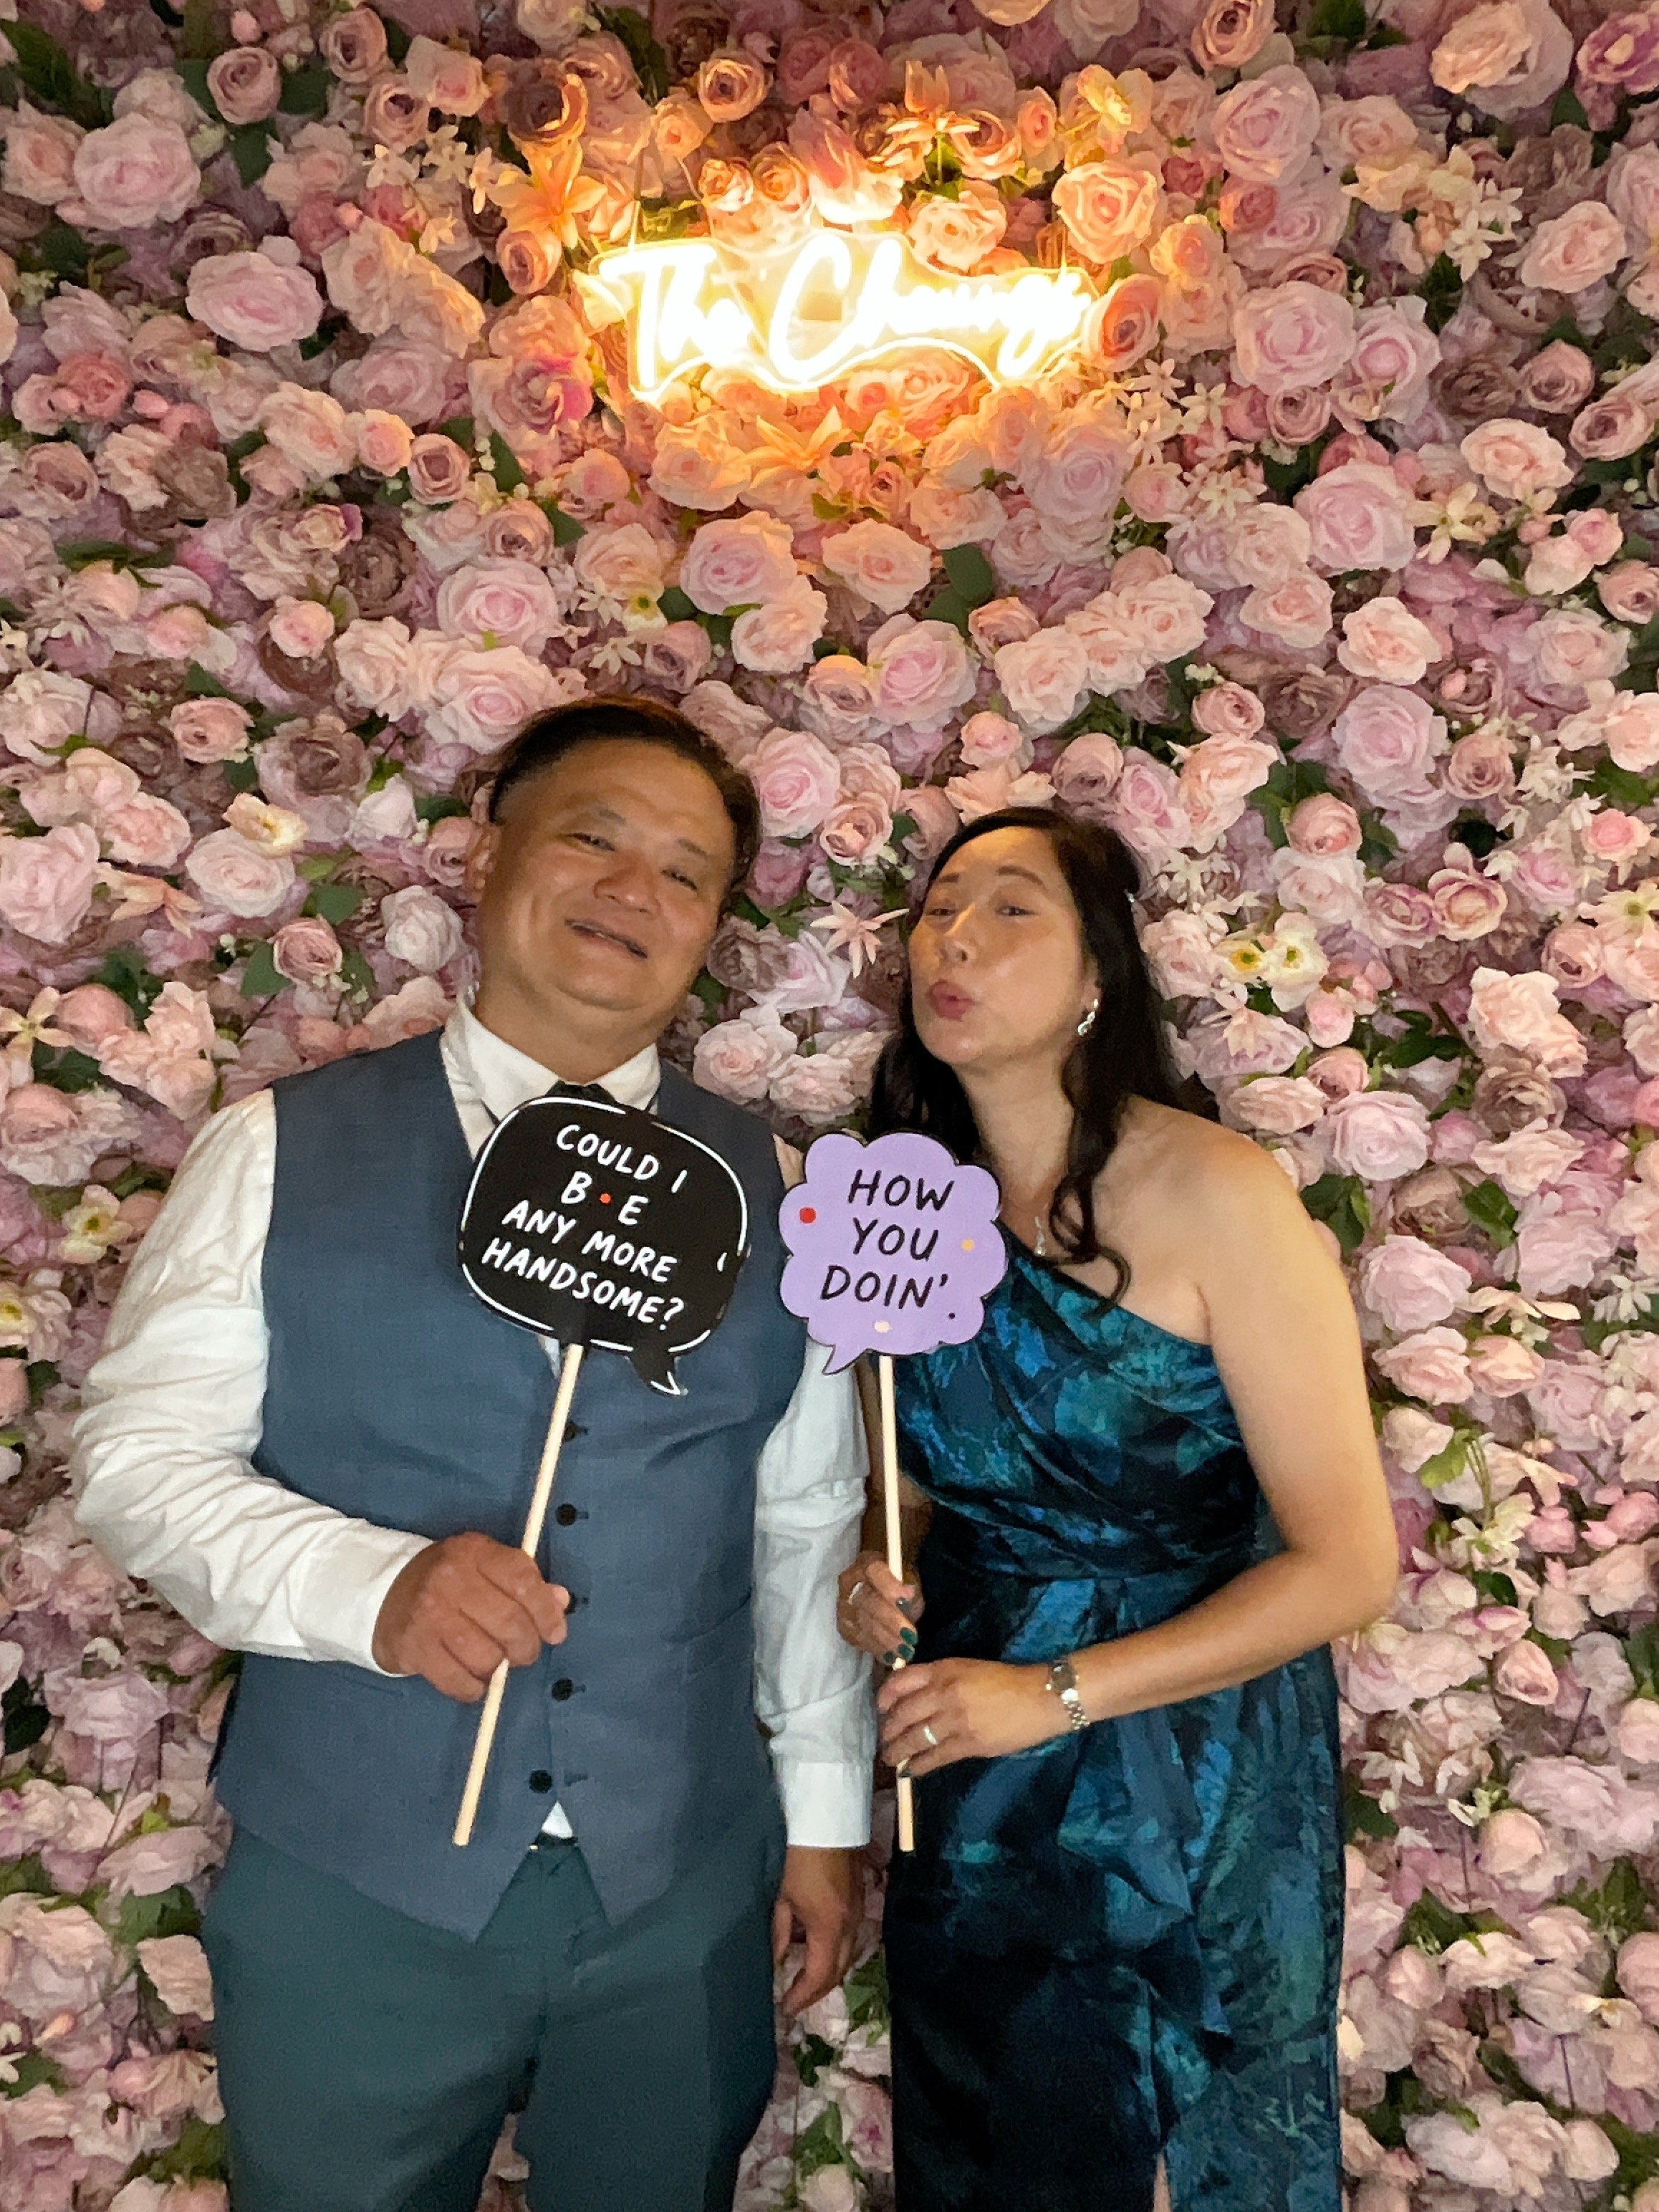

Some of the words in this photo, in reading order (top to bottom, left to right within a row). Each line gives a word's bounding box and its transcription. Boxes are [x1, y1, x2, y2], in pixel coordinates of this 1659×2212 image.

[556, 1125, 660, 1180] COULD
[670, 1169, 688, 1193] I
[847, 1169, 955, 1212] HOW
[501, 1199, 577, 1244] ANY
[581, 1231, 678, 1282] MORE
[852, 1217, 939, 1262] YOU
[481, 1237, 685, 1331] HANDSOME?
